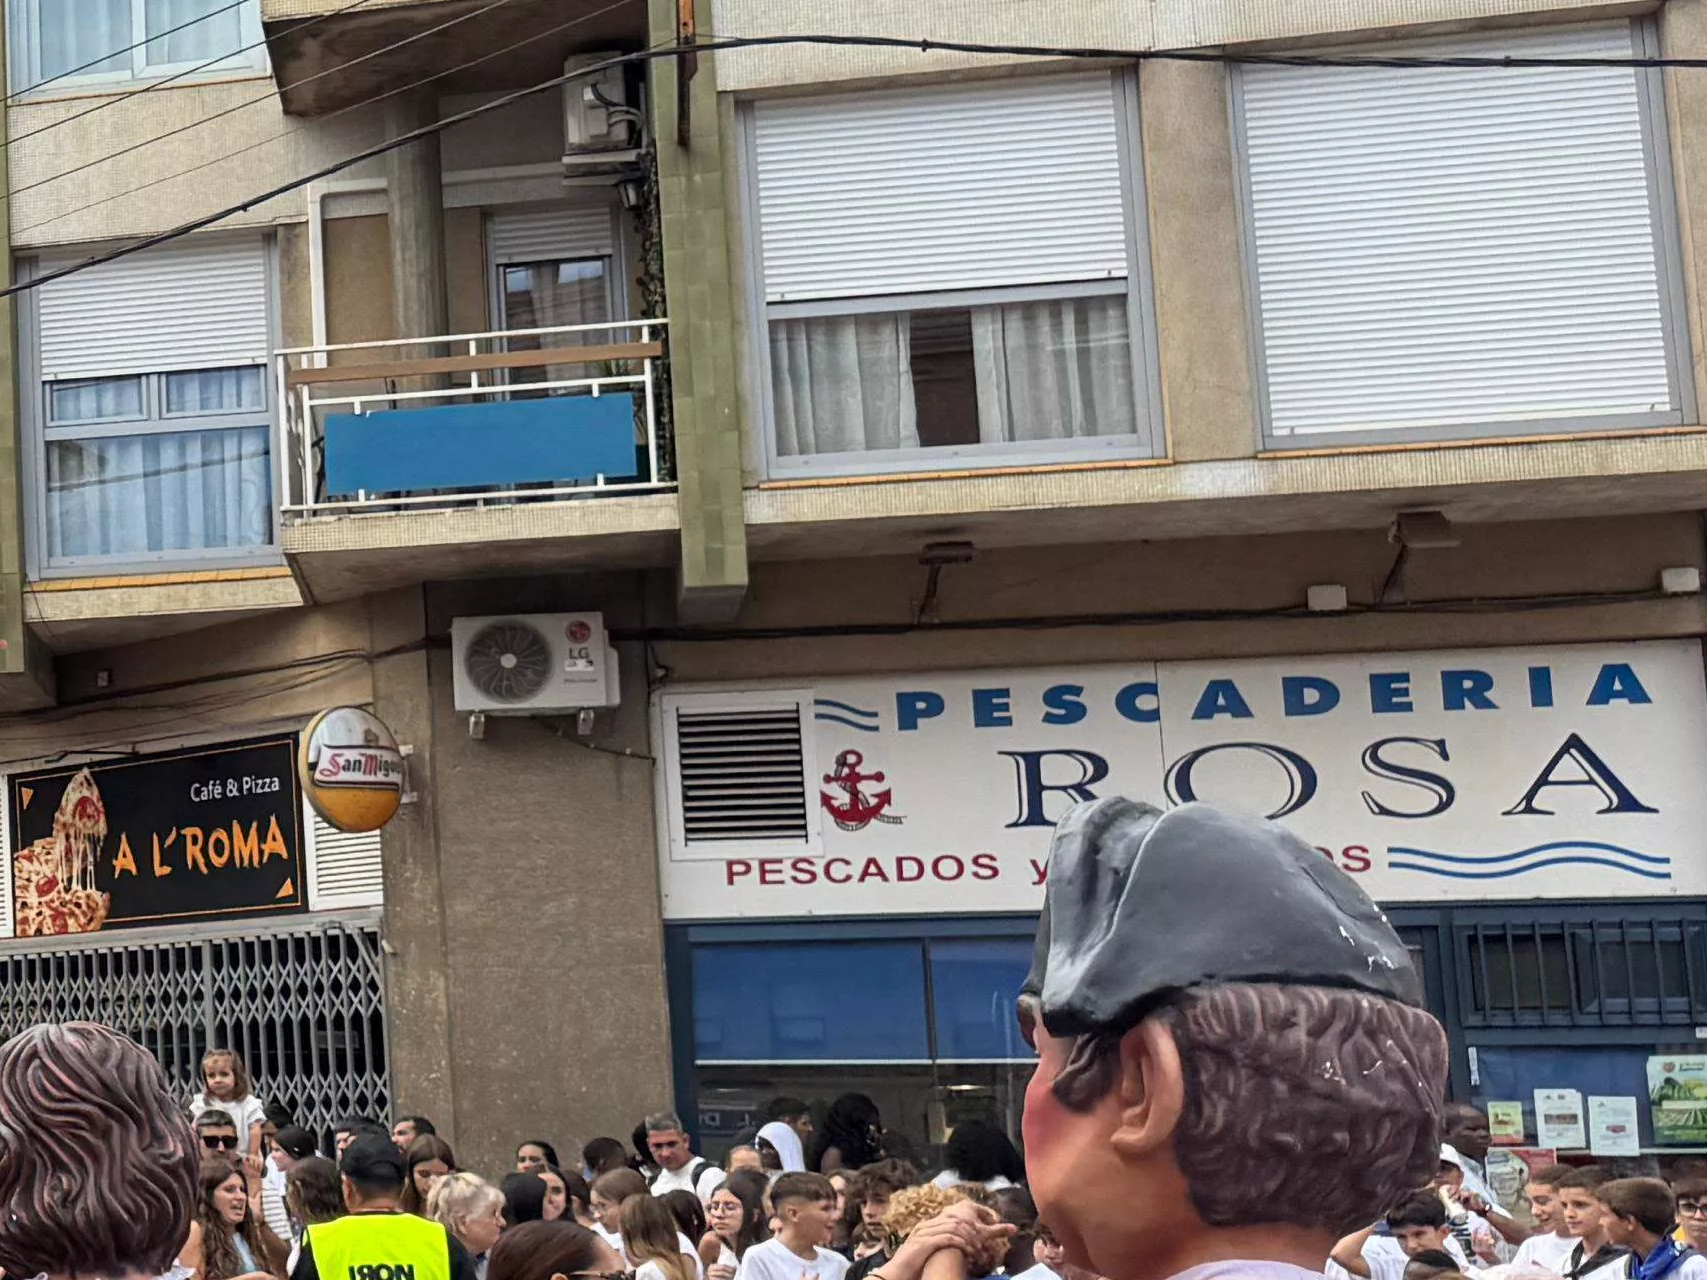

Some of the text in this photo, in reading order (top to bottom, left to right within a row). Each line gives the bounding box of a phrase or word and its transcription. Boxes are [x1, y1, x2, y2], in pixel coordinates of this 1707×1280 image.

[569, 647, 590, 660] LG
[895, 662, 1654, 731] PESCADERIA
[190, 774, 281, 802] Café & Pizza
[996, 731, 1660, 828] ROSA
[112, 831, 138, 879] A
[725, 853, 1001, 886] PESCADOS
